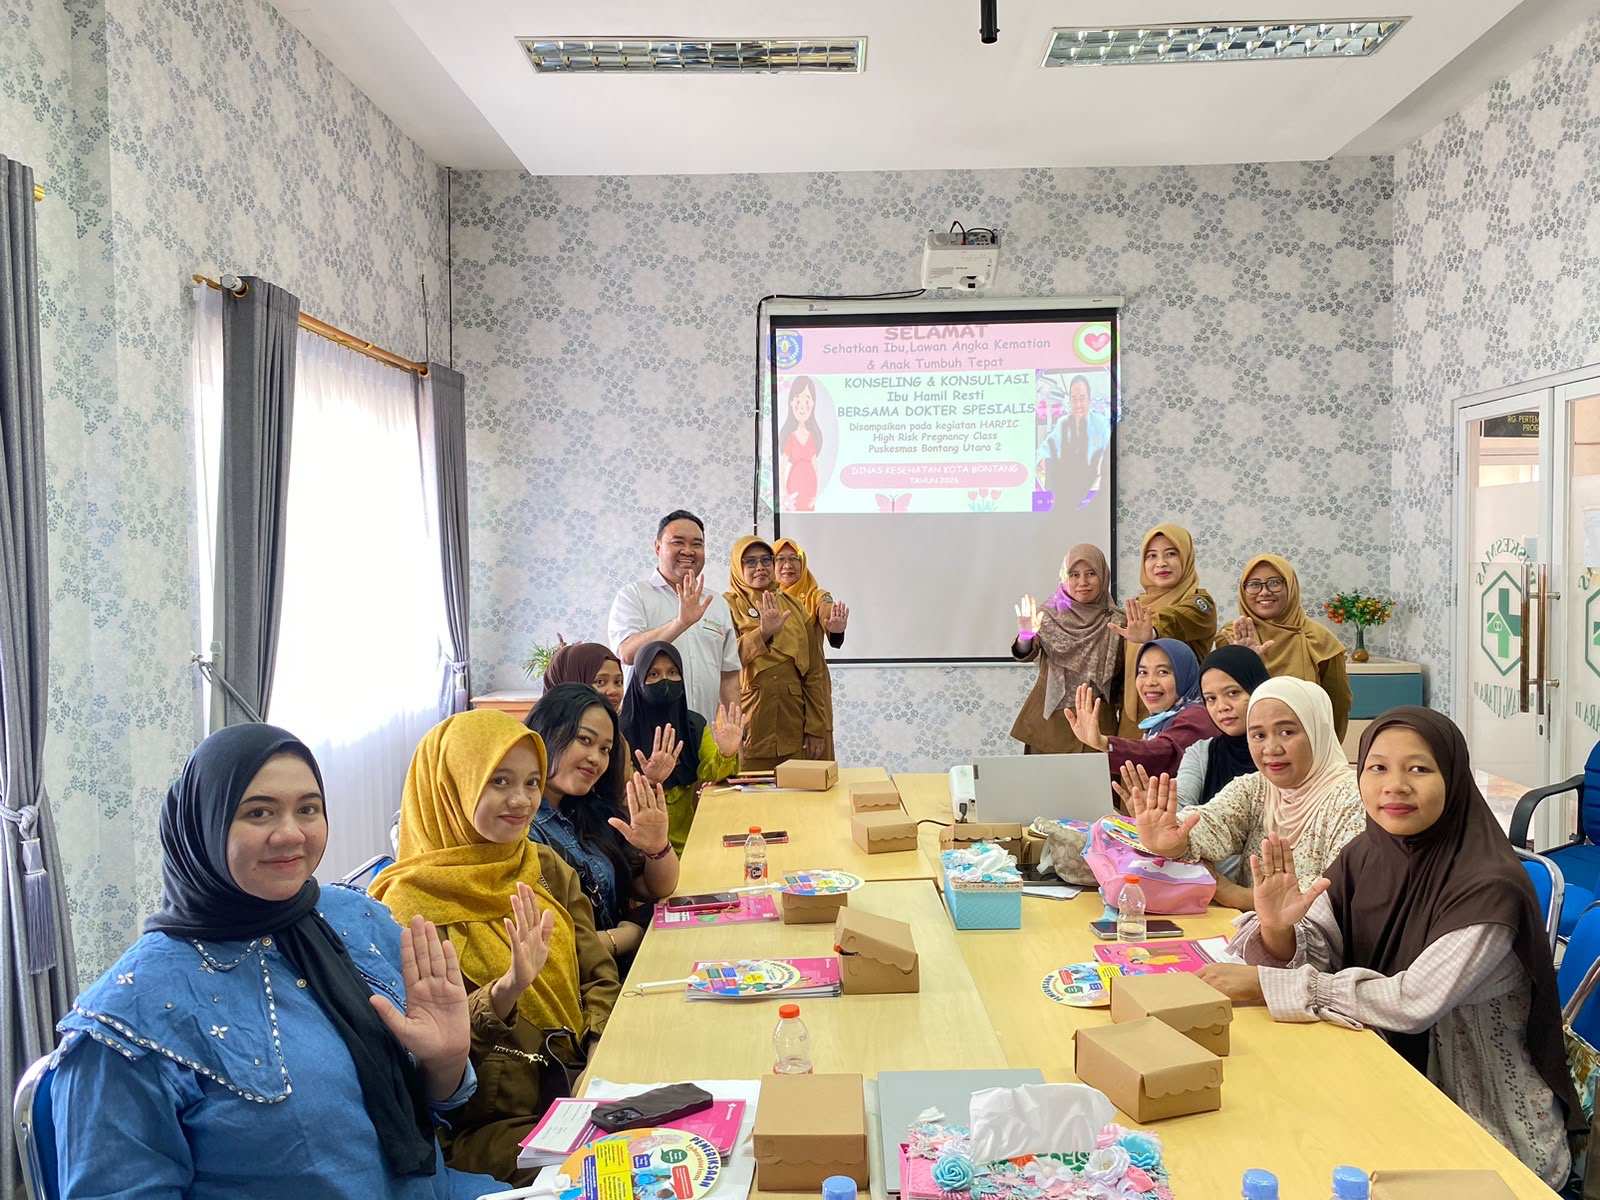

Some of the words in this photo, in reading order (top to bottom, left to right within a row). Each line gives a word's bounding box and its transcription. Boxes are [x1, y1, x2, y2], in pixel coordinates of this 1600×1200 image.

[884, 325, 988, 340] SELAMAT
[823, 343, 878, 354] Sehatkan
[952, 340, 988, 352] Angka
[994, 338, 1050, 350] Kematian
[867, 360, 875, 370] &
[881, 358, 910, 370] Anak
[916, 358, 962, 369] Tumbuh
[968, 356, 1003, 370] Tepat
[844, 376, 921, 389] KONSELING
[927, 376, 936, 387] &
[940, 374, 1030, 386] KONSULTASI
[887, 391, 908, 402] Ibu
[913, 390, 947, 401] Hamil
[953, 390, 984, 400] Resti
[837, 406, 900, 417] BERSAMA
[905, 404, 956, 416] DOKTER
[962, 403, 1034, 415] SPESIALIS
[849, 422, 906, 432] Disampaikan
[909, 422, 932, 432] pada
[936, 420, 976, 431] kegiatan
[979, 420, 1018, 429] HARPIC
[873, 432, 894, 443] High
[898, 432, 918, 442] Risk
[920, 432, 969, 442] Pregnancy
[973, 431, 998, 440] Class
[868, 444, 918, 453] Puskesmas
[920, 444, 959, 454] Bontang
[962, 442, 992, 452] Utara
[995, 442, 1002, 451] 2
[689, 1136, 720, 1188] PEMERIKSAAN
